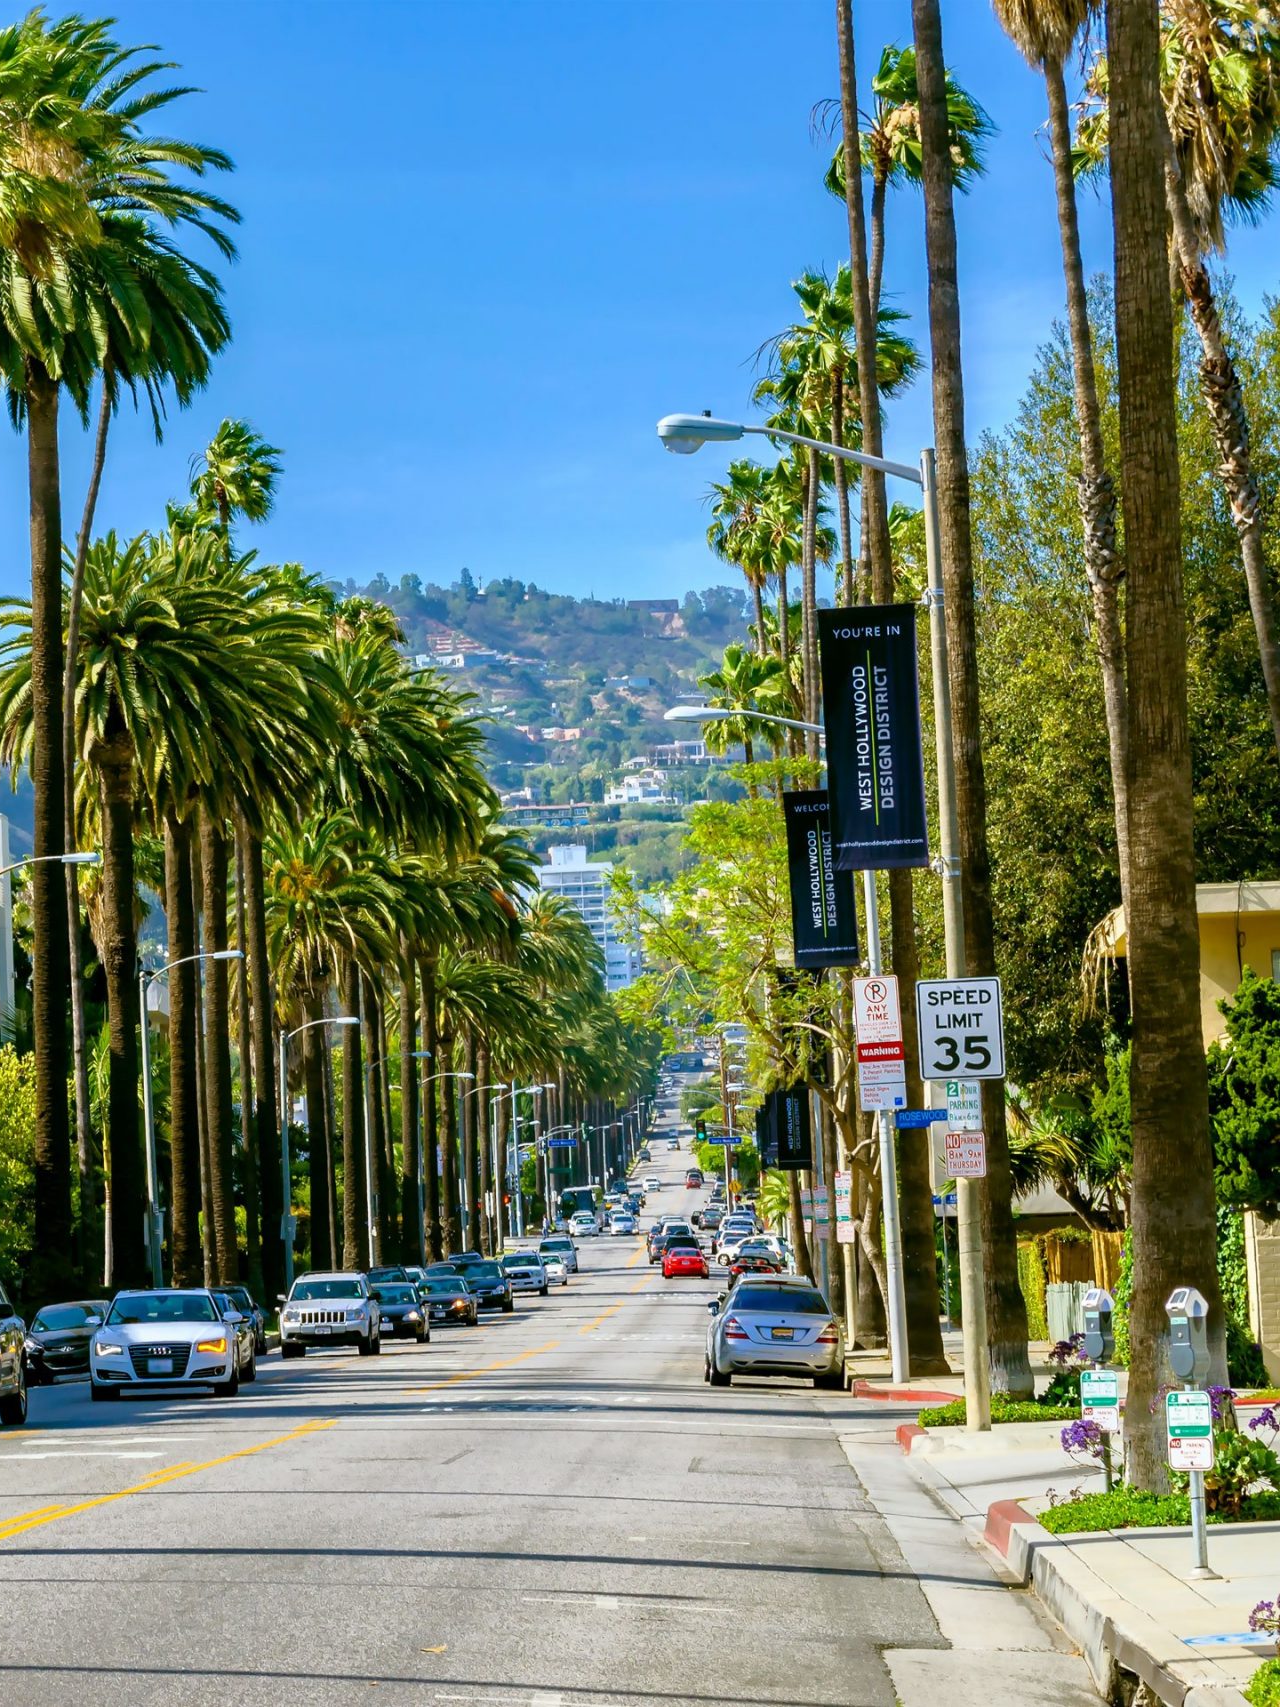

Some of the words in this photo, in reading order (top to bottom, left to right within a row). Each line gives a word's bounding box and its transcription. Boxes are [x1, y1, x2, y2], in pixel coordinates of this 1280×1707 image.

[832, 626, 881, 639] YOU'RE
[886, 625, 901, 637] IN
[873, 666, 892, 740] DISTRICT
[852, 665, 871, 767] HOLLYWOOD
[879, 743, 895, 809] DESIGN
[860, 772, 873, 811] WEST
[807, 830, 821, 898] HOLLYWOOD
[822, 831, 834, 884] DISTRICT
[812, 901, 823, 928] WEST
[825, 886, 837, 927] DESIGN
[927, 989, 991, 1006] SPEED
[867, 1004, 887, 1012] ANY
[935, 1013, 983, 1029] LIMIT
[861, 1047, 900, 1057] WARNING
[933, 1035, 992, 1071] 35
[949, 1085, 956, 1095] 2
[949, 1100, 978, 1110] PARKING
[899, 1111, 946, 1121] ROSEWOOD
[946, 1136, 959, 1148] NO
[960, 1136, 982, 1145] PARKING
[949, 1150, 963, 1159] 8AM
[968, 1149, 981, 1158] 9AM
[949, 1161, 980, 1169] THURSDAY
